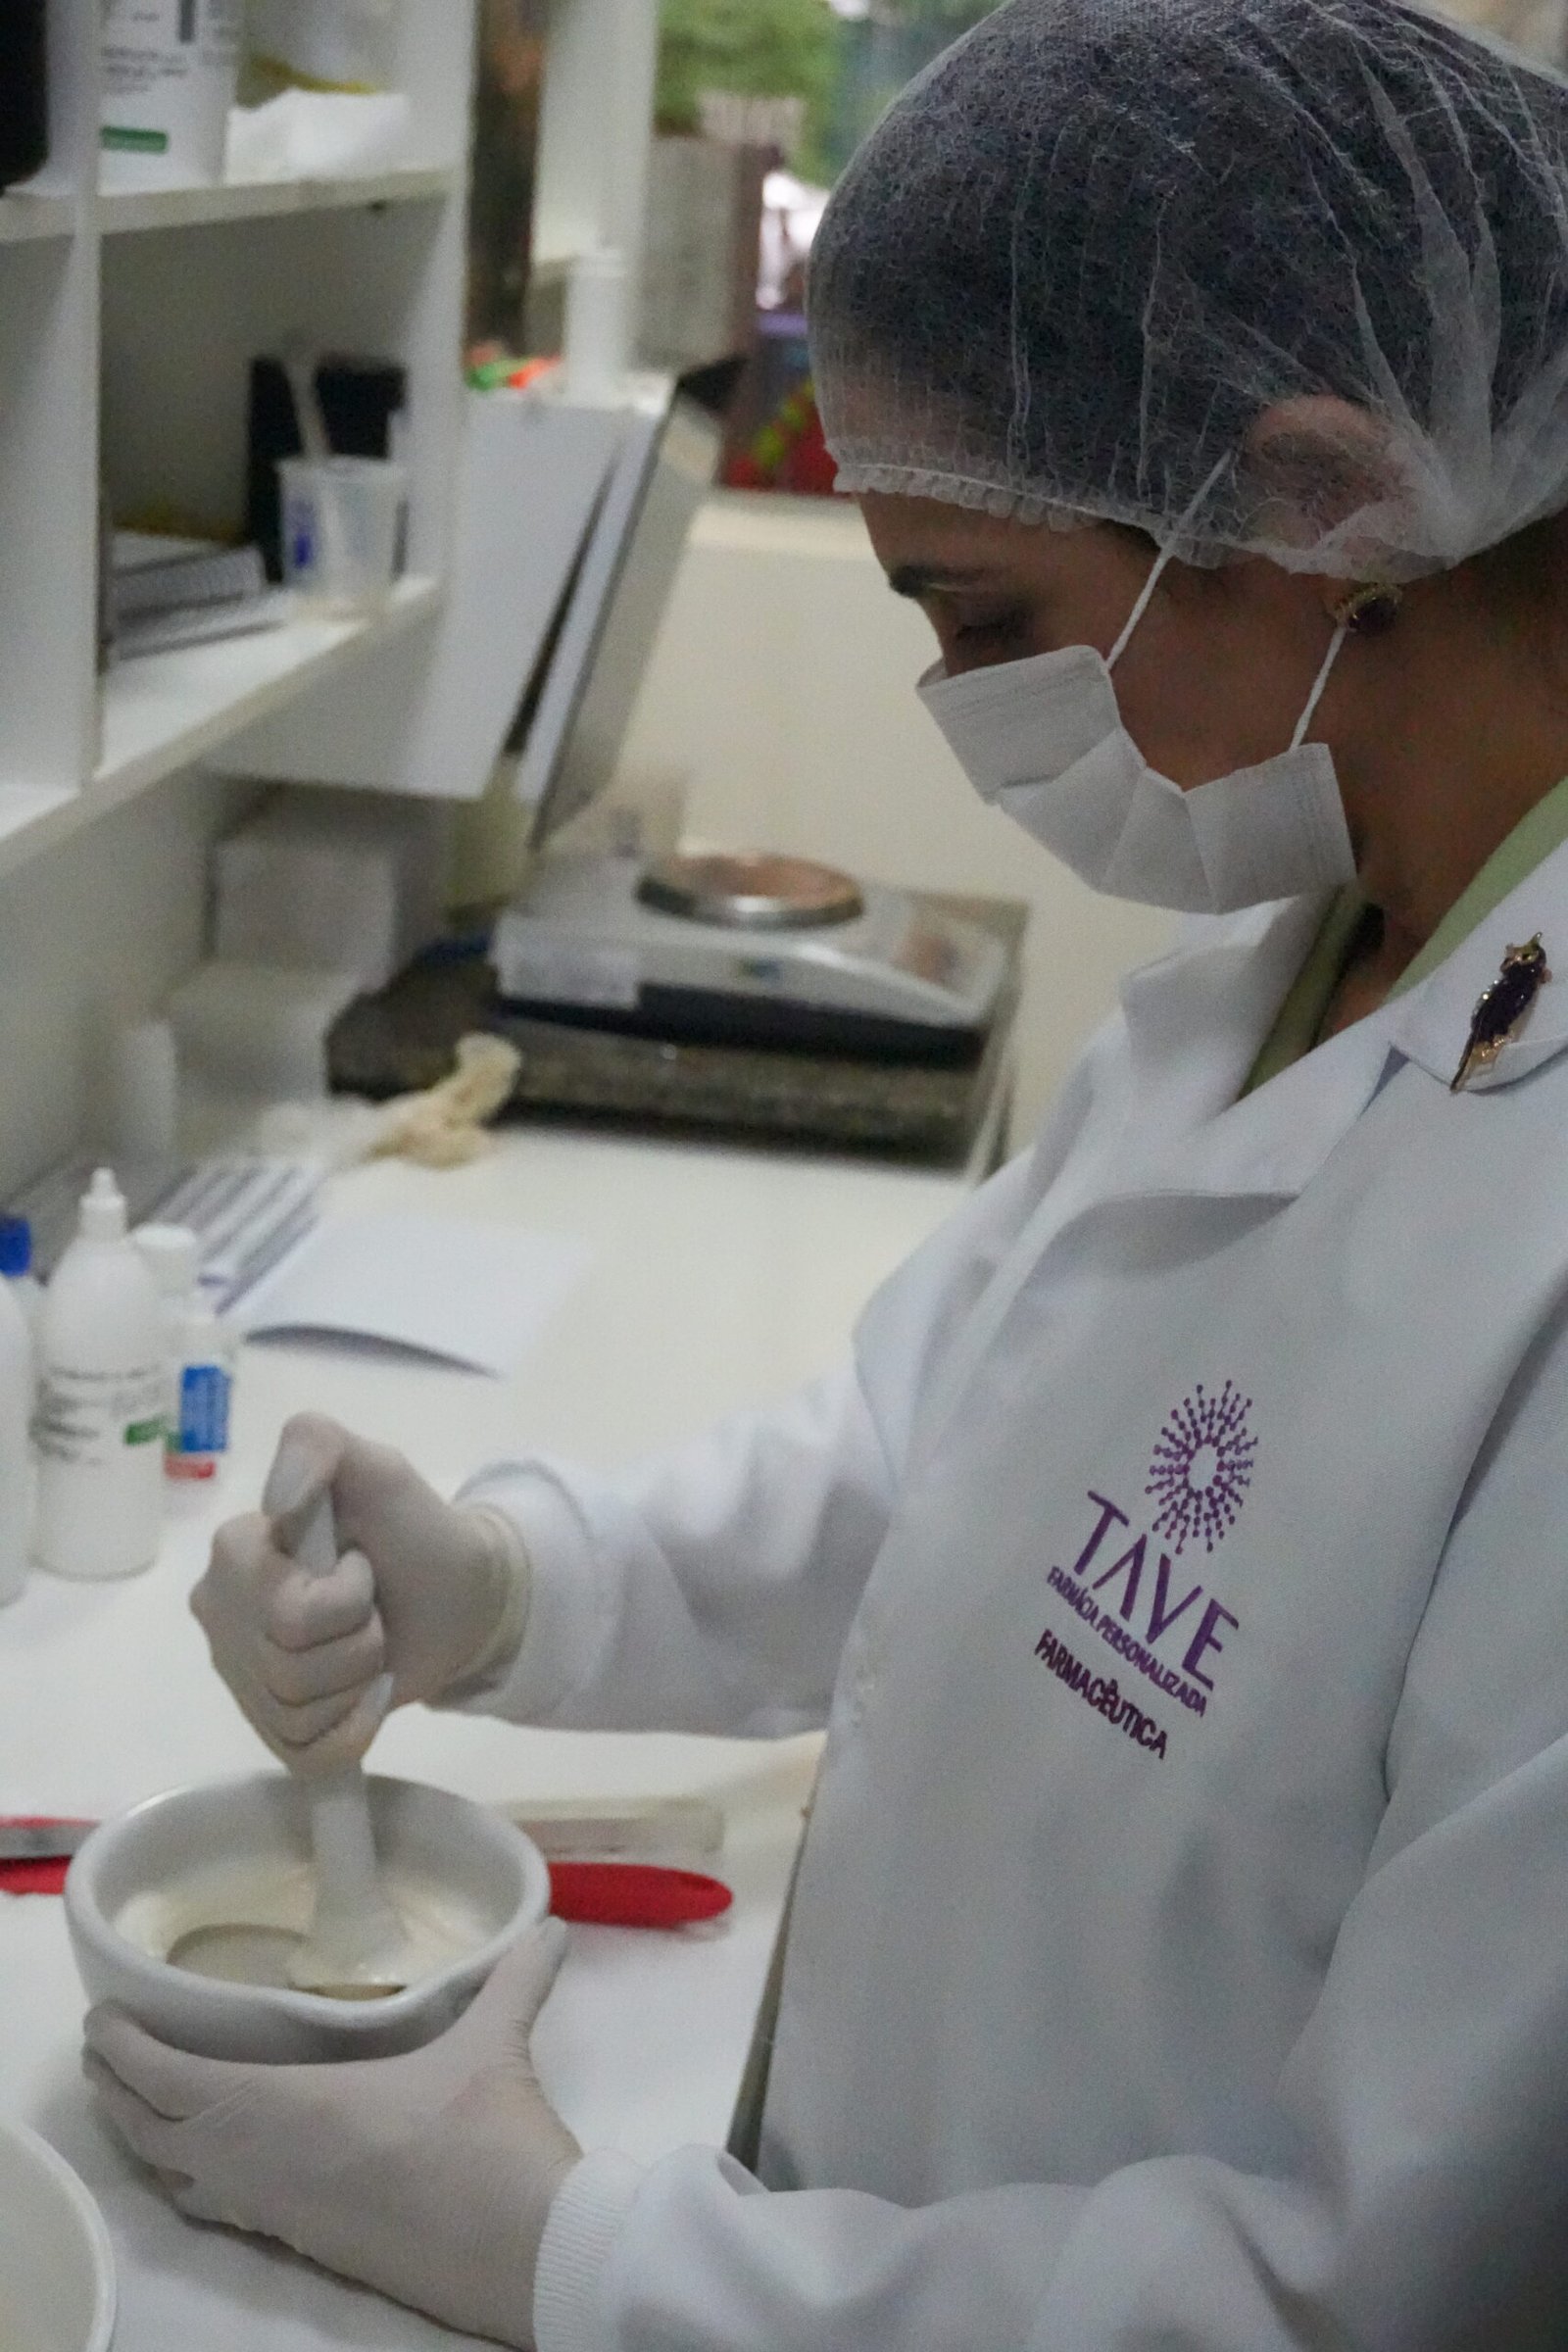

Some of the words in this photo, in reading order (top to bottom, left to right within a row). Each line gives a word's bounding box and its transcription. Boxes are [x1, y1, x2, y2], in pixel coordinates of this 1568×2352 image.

[1074, 1491, 1239, 1690] TAVE
[1034, 1628, 1168, 1760] FARMACÊUTICA
[1100, 1614, 1206, 1717] PERSONALIZADA
